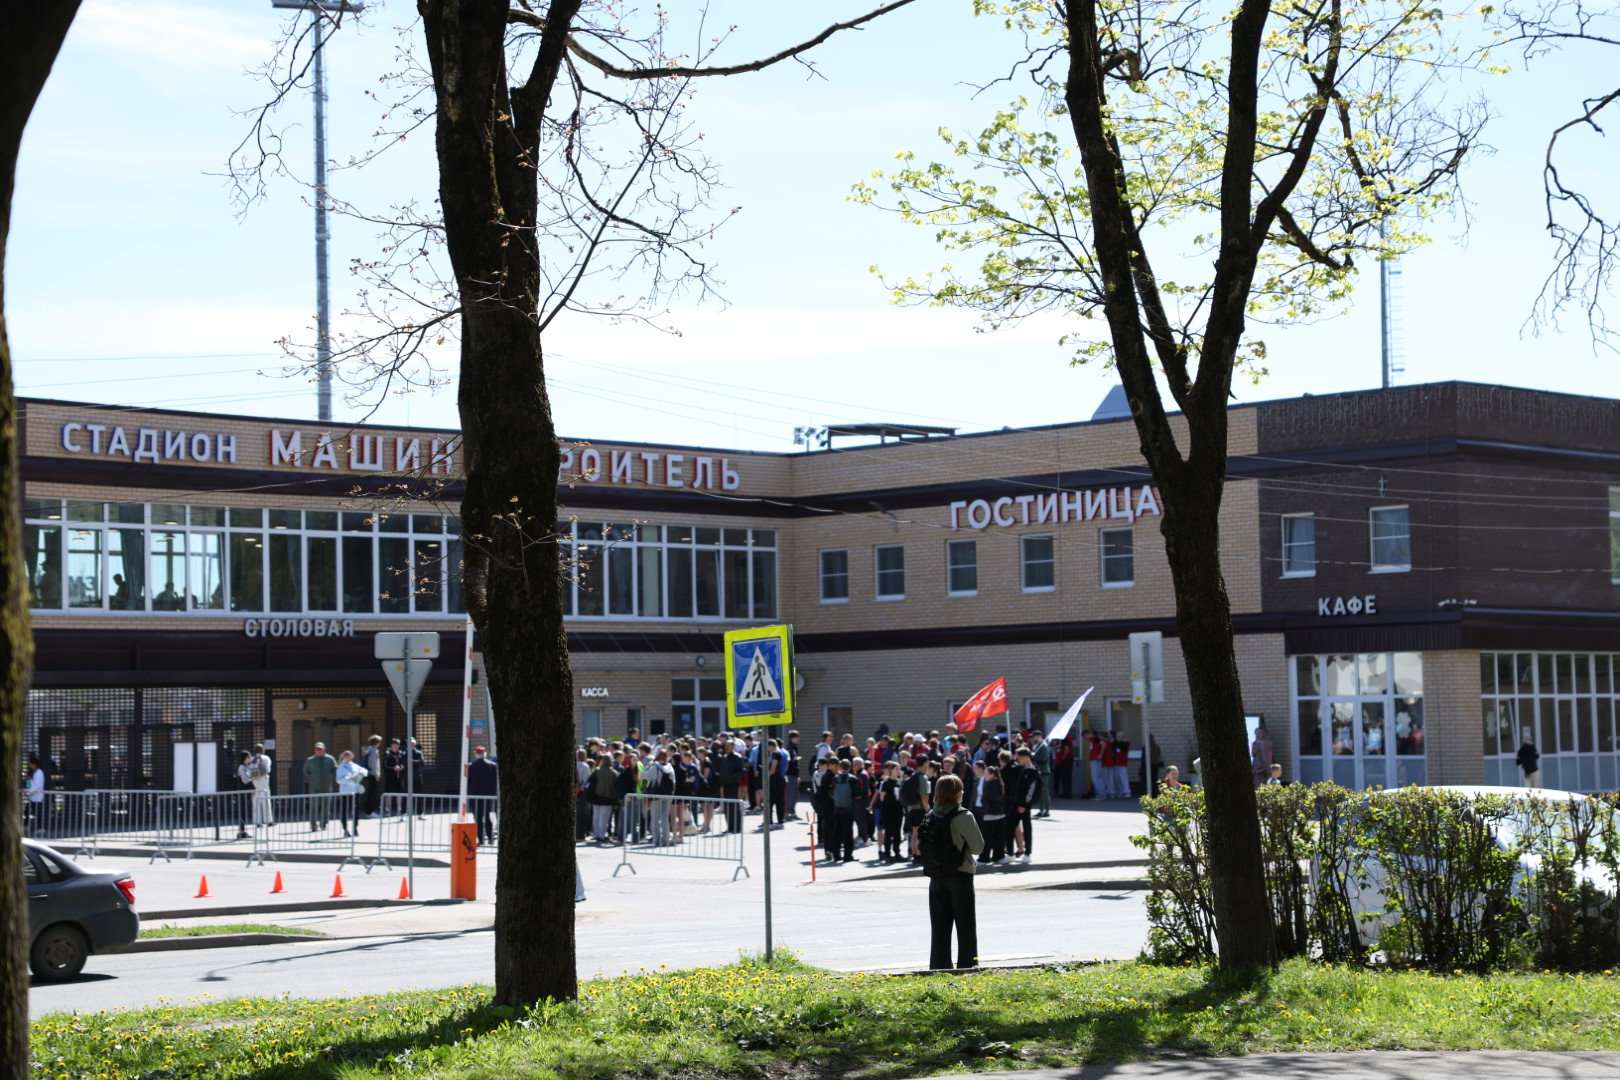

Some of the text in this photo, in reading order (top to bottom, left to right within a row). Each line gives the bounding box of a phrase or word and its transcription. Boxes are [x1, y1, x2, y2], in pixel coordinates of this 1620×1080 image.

[61, 422, 740, 490] СТАДИОН МАШИНРОИТЕЛЬ
[951, 485, 1162, 531] ГОСТИНИЦА
[1317, 595, 1378, 616] КАФЕ
[243, 618, 355, 638] СТОЛОВАЯ
[581, 687, 609, 697] КАССА
